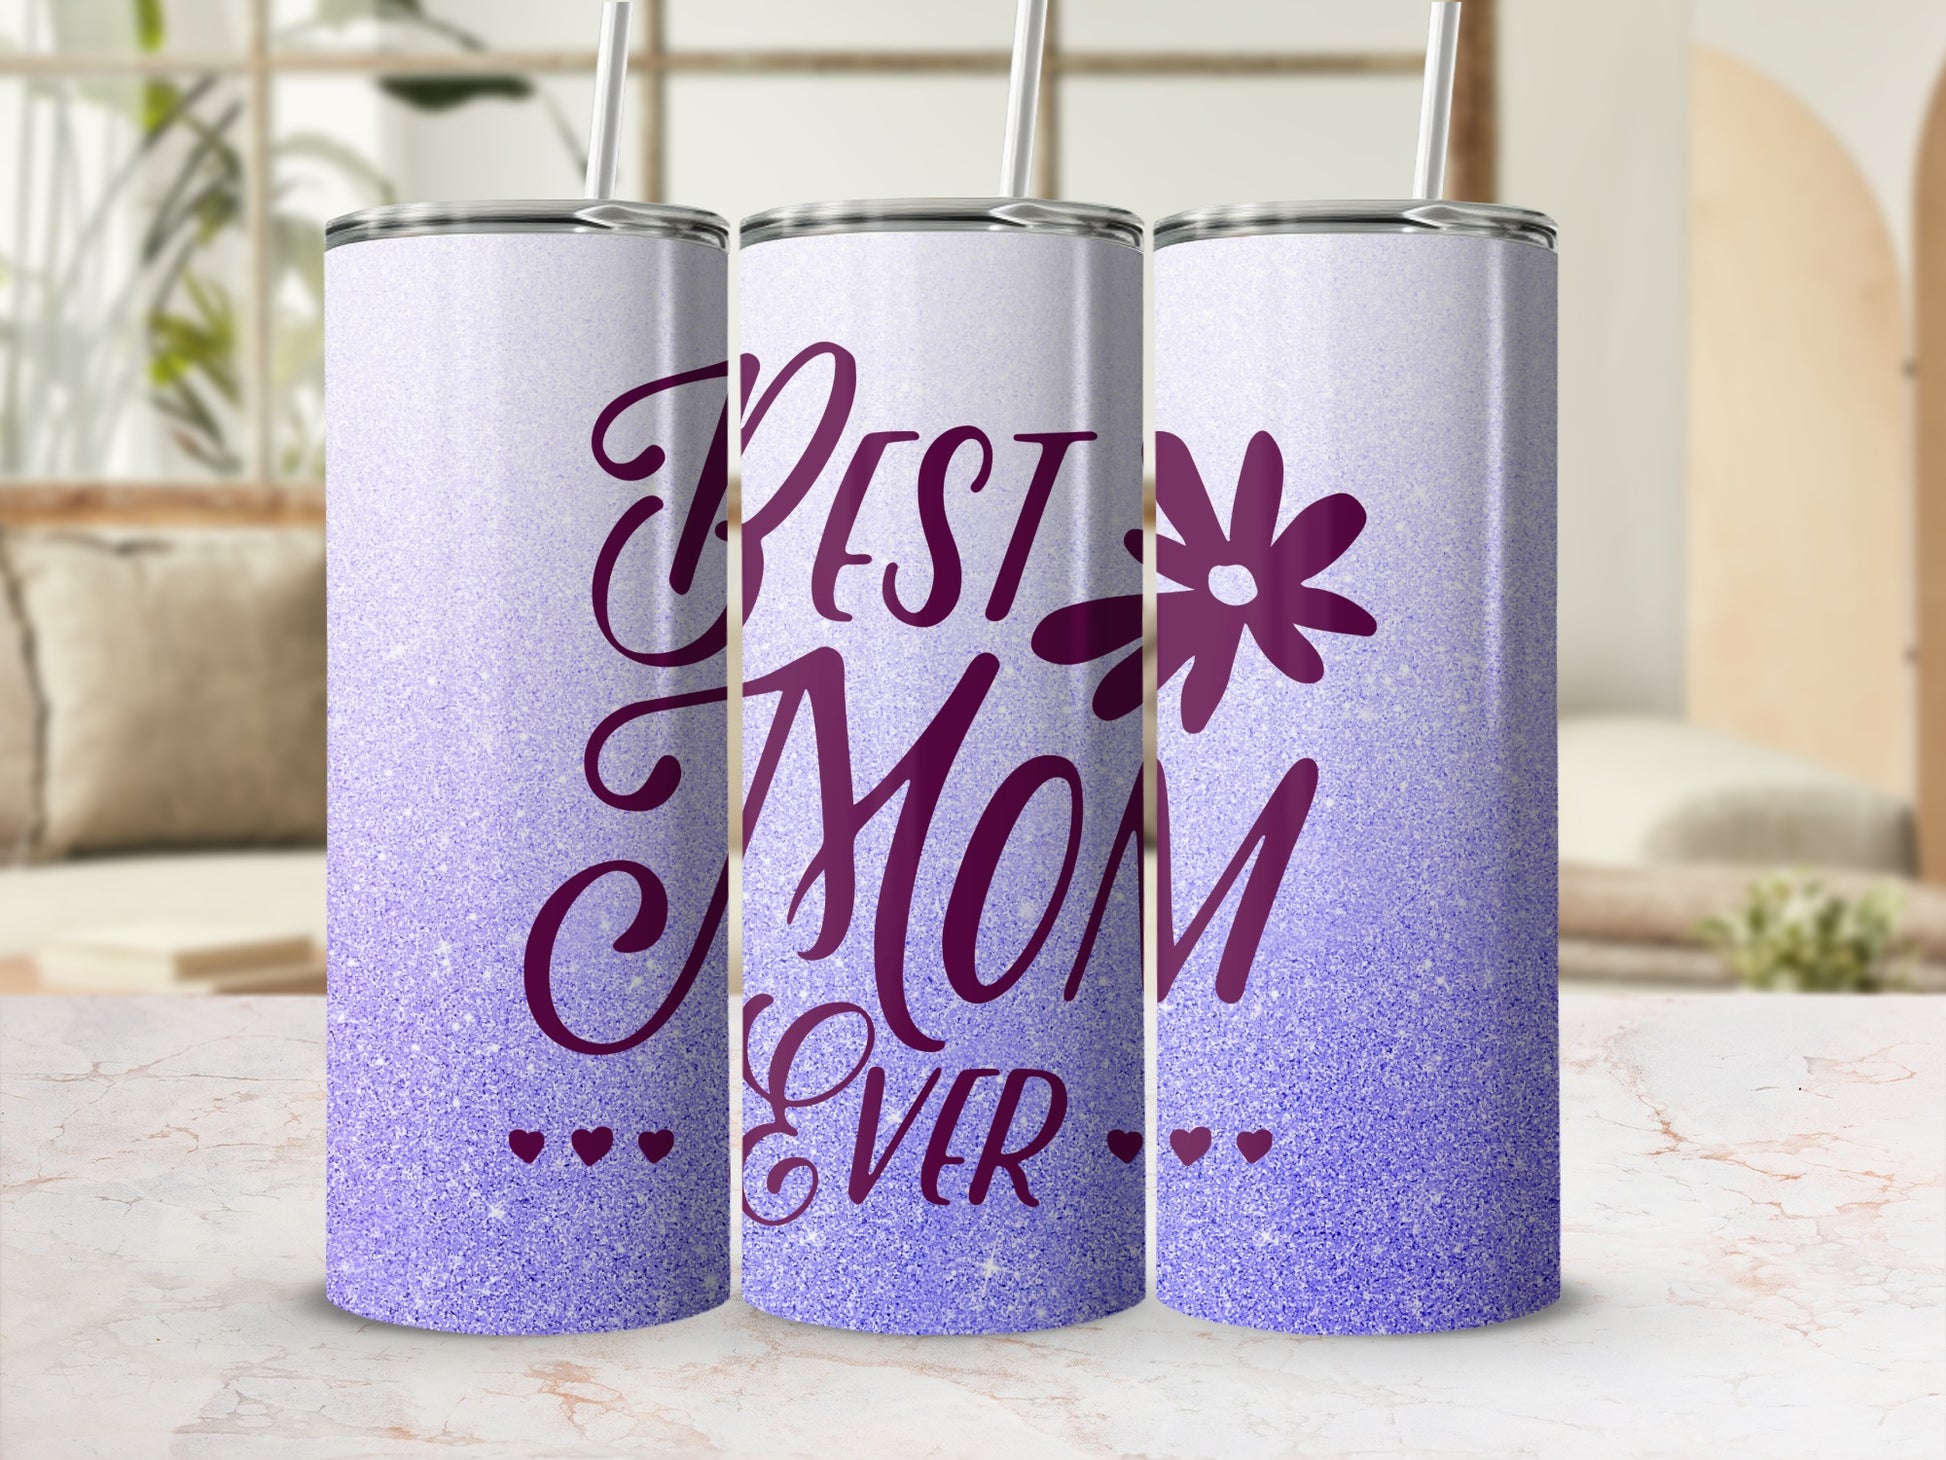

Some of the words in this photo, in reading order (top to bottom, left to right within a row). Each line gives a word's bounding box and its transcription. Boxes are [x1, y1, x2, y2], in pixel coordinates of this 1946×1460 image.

[591, 341, 1097, 667] BEST
[524, 646, 1318, 1055] MOM
[741, 993, 1067, 1226] EVER
